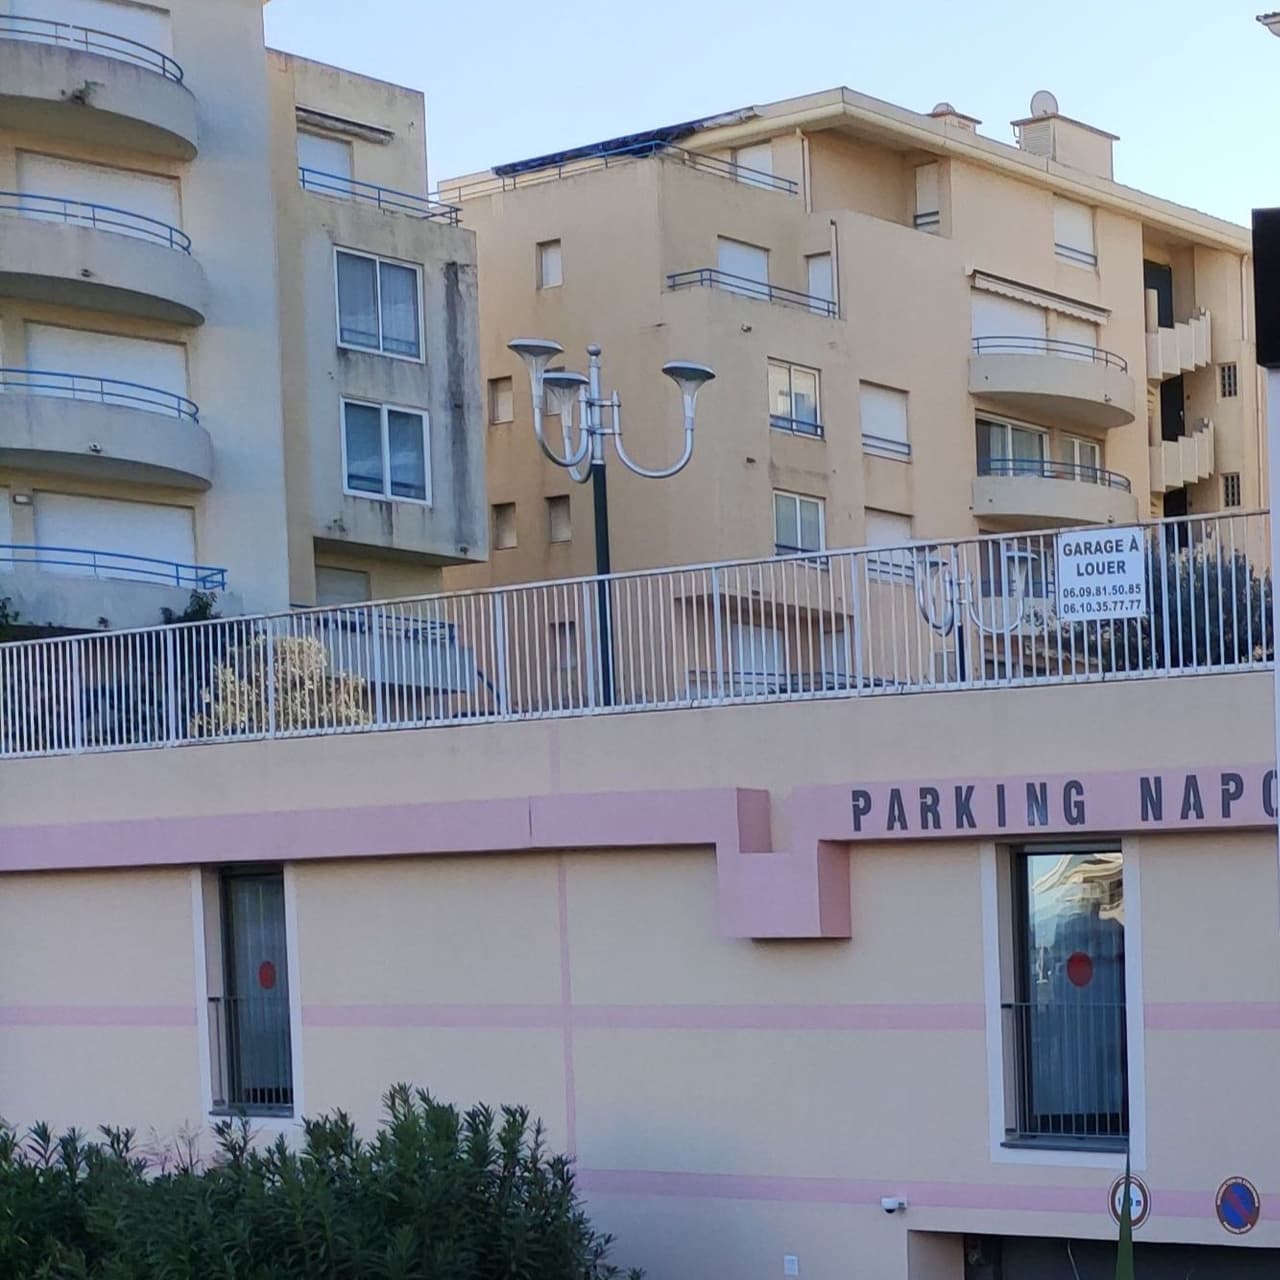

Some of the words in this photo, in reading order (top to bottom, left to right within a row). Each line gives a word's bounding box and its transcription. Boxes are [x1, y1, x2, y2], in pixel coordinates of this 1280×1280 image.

[1062, 539, 1124, 557] GARAGE
[1076, 560, 1126, 577] LOUER
[1062, 583, 1142, 599] 06.09.81.50.85
[1063, 600, 1142, 614] 06.10.35.77.77
[851, 779, 1085, 833] PARKING
